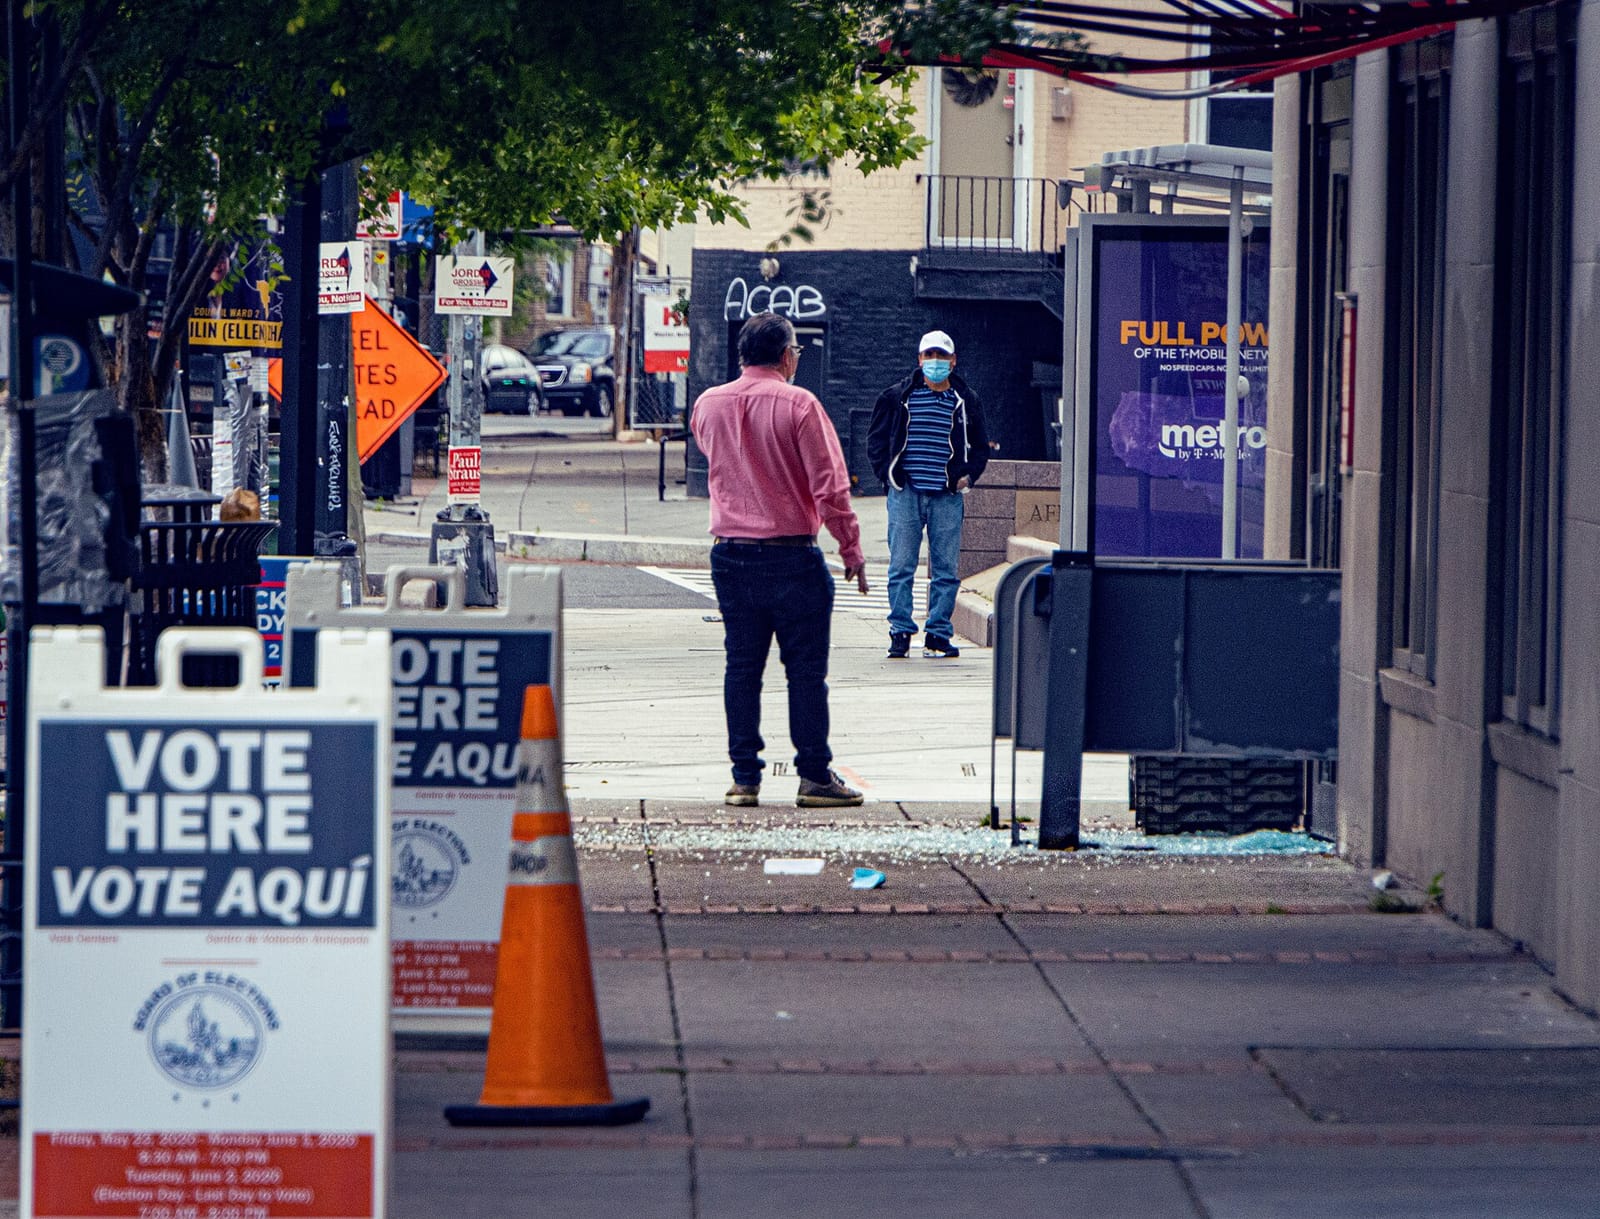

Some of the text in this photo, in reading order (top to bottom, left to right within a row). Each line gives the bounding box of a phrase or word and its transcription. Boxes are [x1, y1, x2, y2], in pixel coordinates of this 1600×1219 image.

[724, 277, 827, 320] ACAB
[229, 309, 253, 318] WARD
[1120, 320, 1194, 345] FULL
[1134, 347, 1151, 359] OF
[1154, 348, 1176, 359] THE
[1173, 364, 1195, 372] SPEED
[356, 399, 395, 420] AD
[1179, 450, 1191, 461] by
[268, 643, 280, 659] 2
[105, 729, 311, 792] VOTE
[106, 793, 312, 853] HERE
[52, 854, 371, 925] VOTE AQUÍ
[203, 970, 280, 1031] ELECTIONS
[101, 1133, 129, 1146] May
[244, 1150, 270, 1164] PM
[190, 1169, 221, 1183] June
[157, 1187, 184, 1203] Day
[195, 1187, 226, 1202] Last
[227, 1188, 255, 1203] Day
